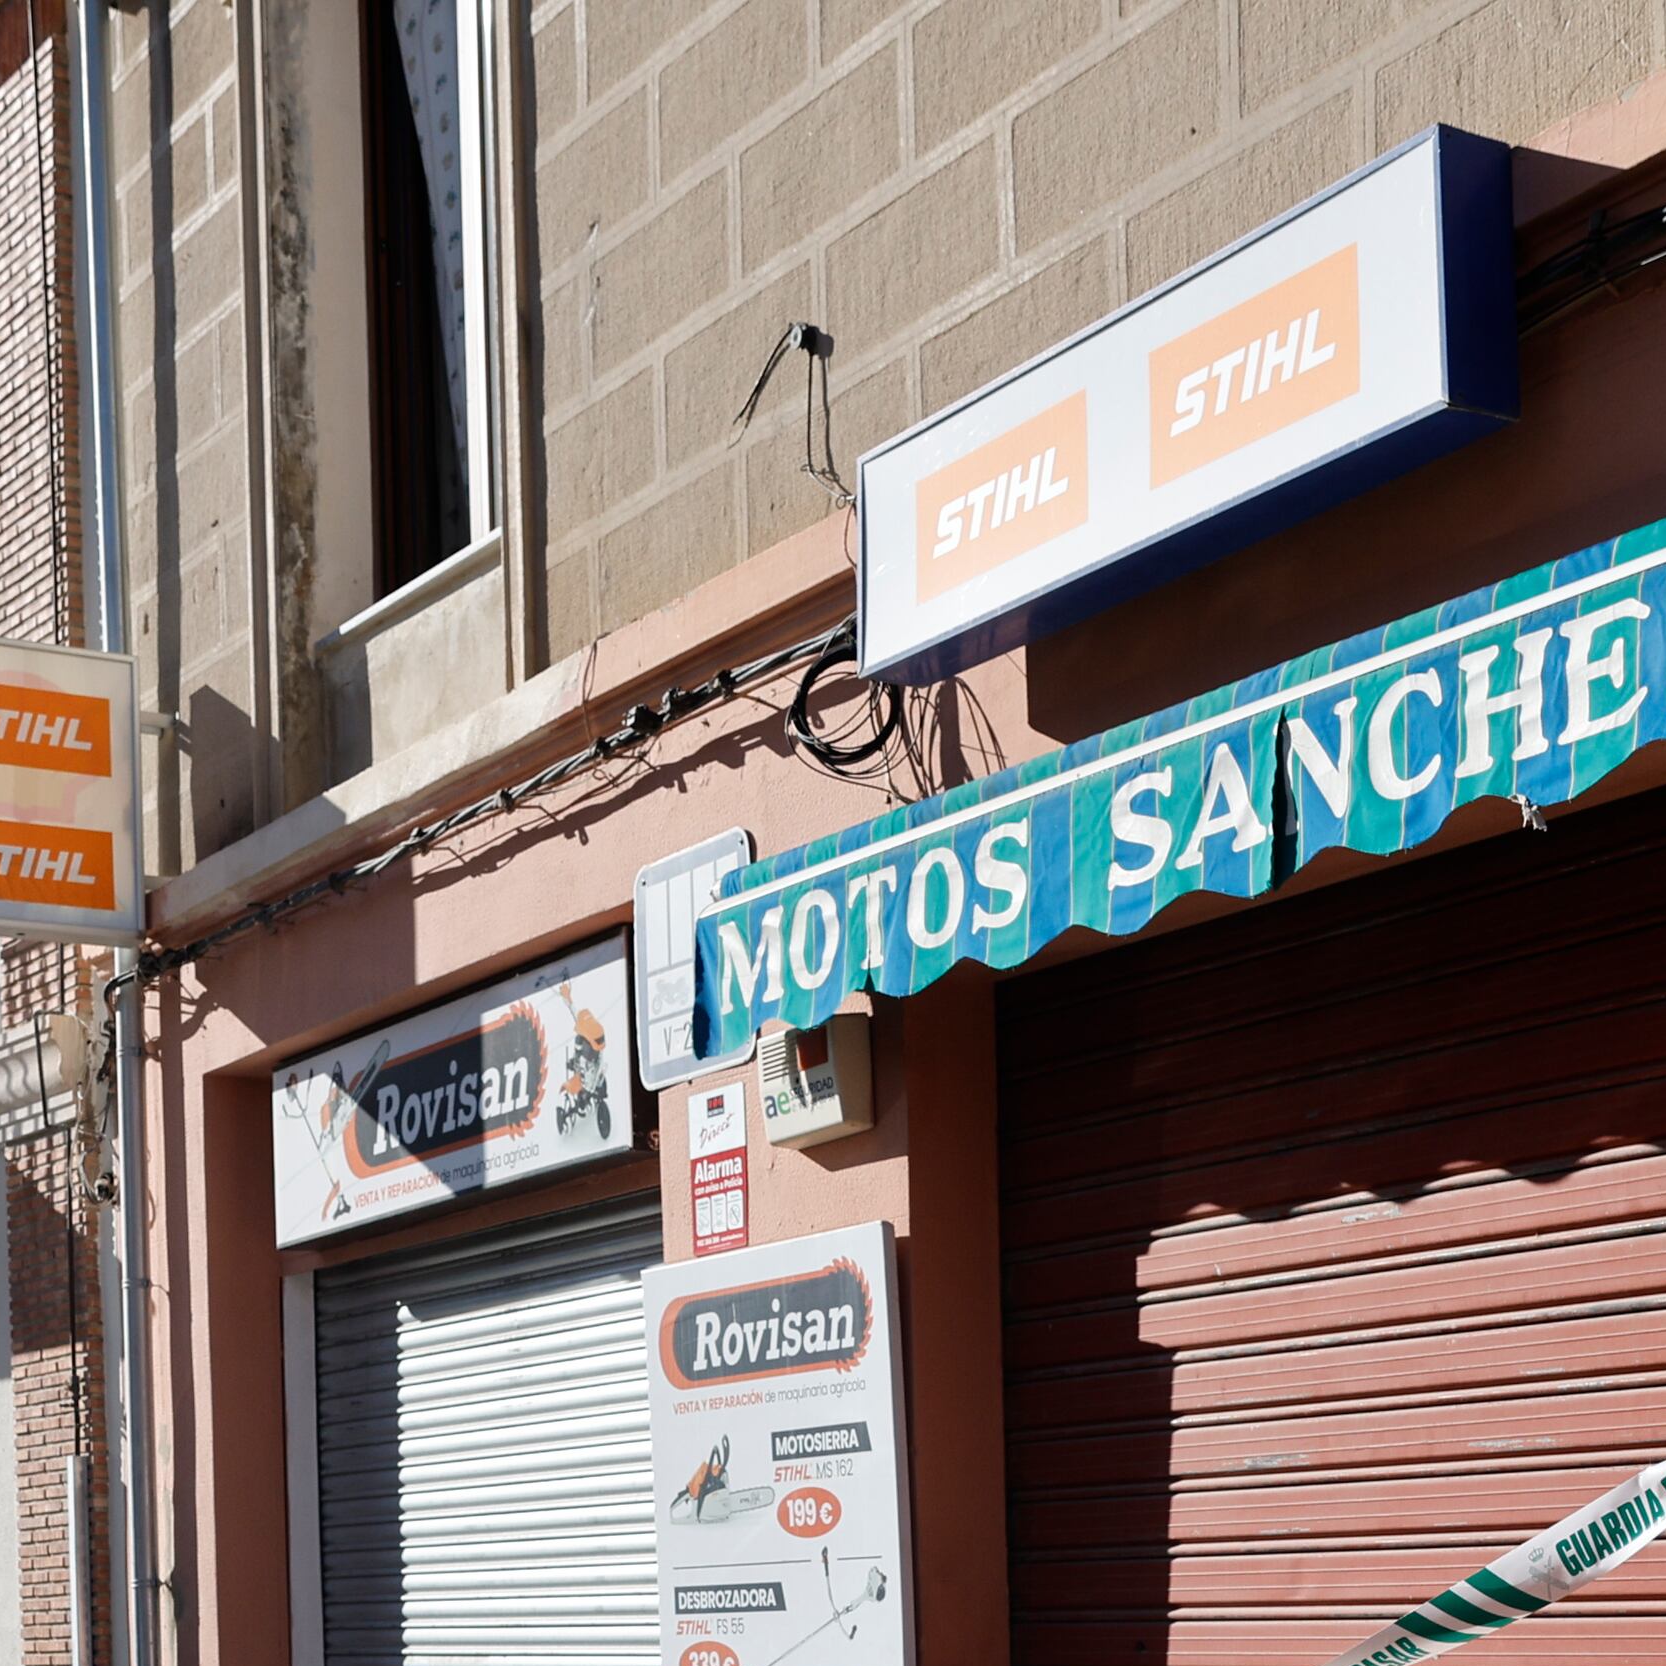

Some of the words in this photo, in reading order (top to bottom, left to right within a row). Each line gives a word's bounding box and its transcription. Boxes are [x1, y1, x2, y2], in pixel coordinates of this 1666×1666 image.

[1169, 308, 1336, 438] STIHL
[933, 446, 1070, 560] STIHL
[717, 818, 1031, 1017] MOTOS
[373, 1057, 531, 1157] Rovisan
[694, 1156, 743, 1185] Alarma
[353, 1193, 380, 1209] VENTA
[440, 1170, 452, 1184] de
[693, 1298, 856, 1372] Rovisan
[673, 1400, 701, 1416] VENTA
[764, 1390, 776, 1403] de
[777, 1381, 829, 1403] maquinaria
[775, 1428, 859, 1457] MOTOSIERRA
[773, 1463, 813, 1483] STIHL
[815, 1461, 833, 1480] MS
[835, 1458, 854, 1477] 162
[786, 1497, 816, 1528] 199
[818, 1502, 834, 1518] €
[1555, 1488, 1666, 1578] GUARDIA
[678, 1587, 777, 1610] DESBROZADORA
[676, 1620, 712, 1636] STIHL
[716, 1618, 729, 1634] FS
[730, 1617, 745, 1634] 55
